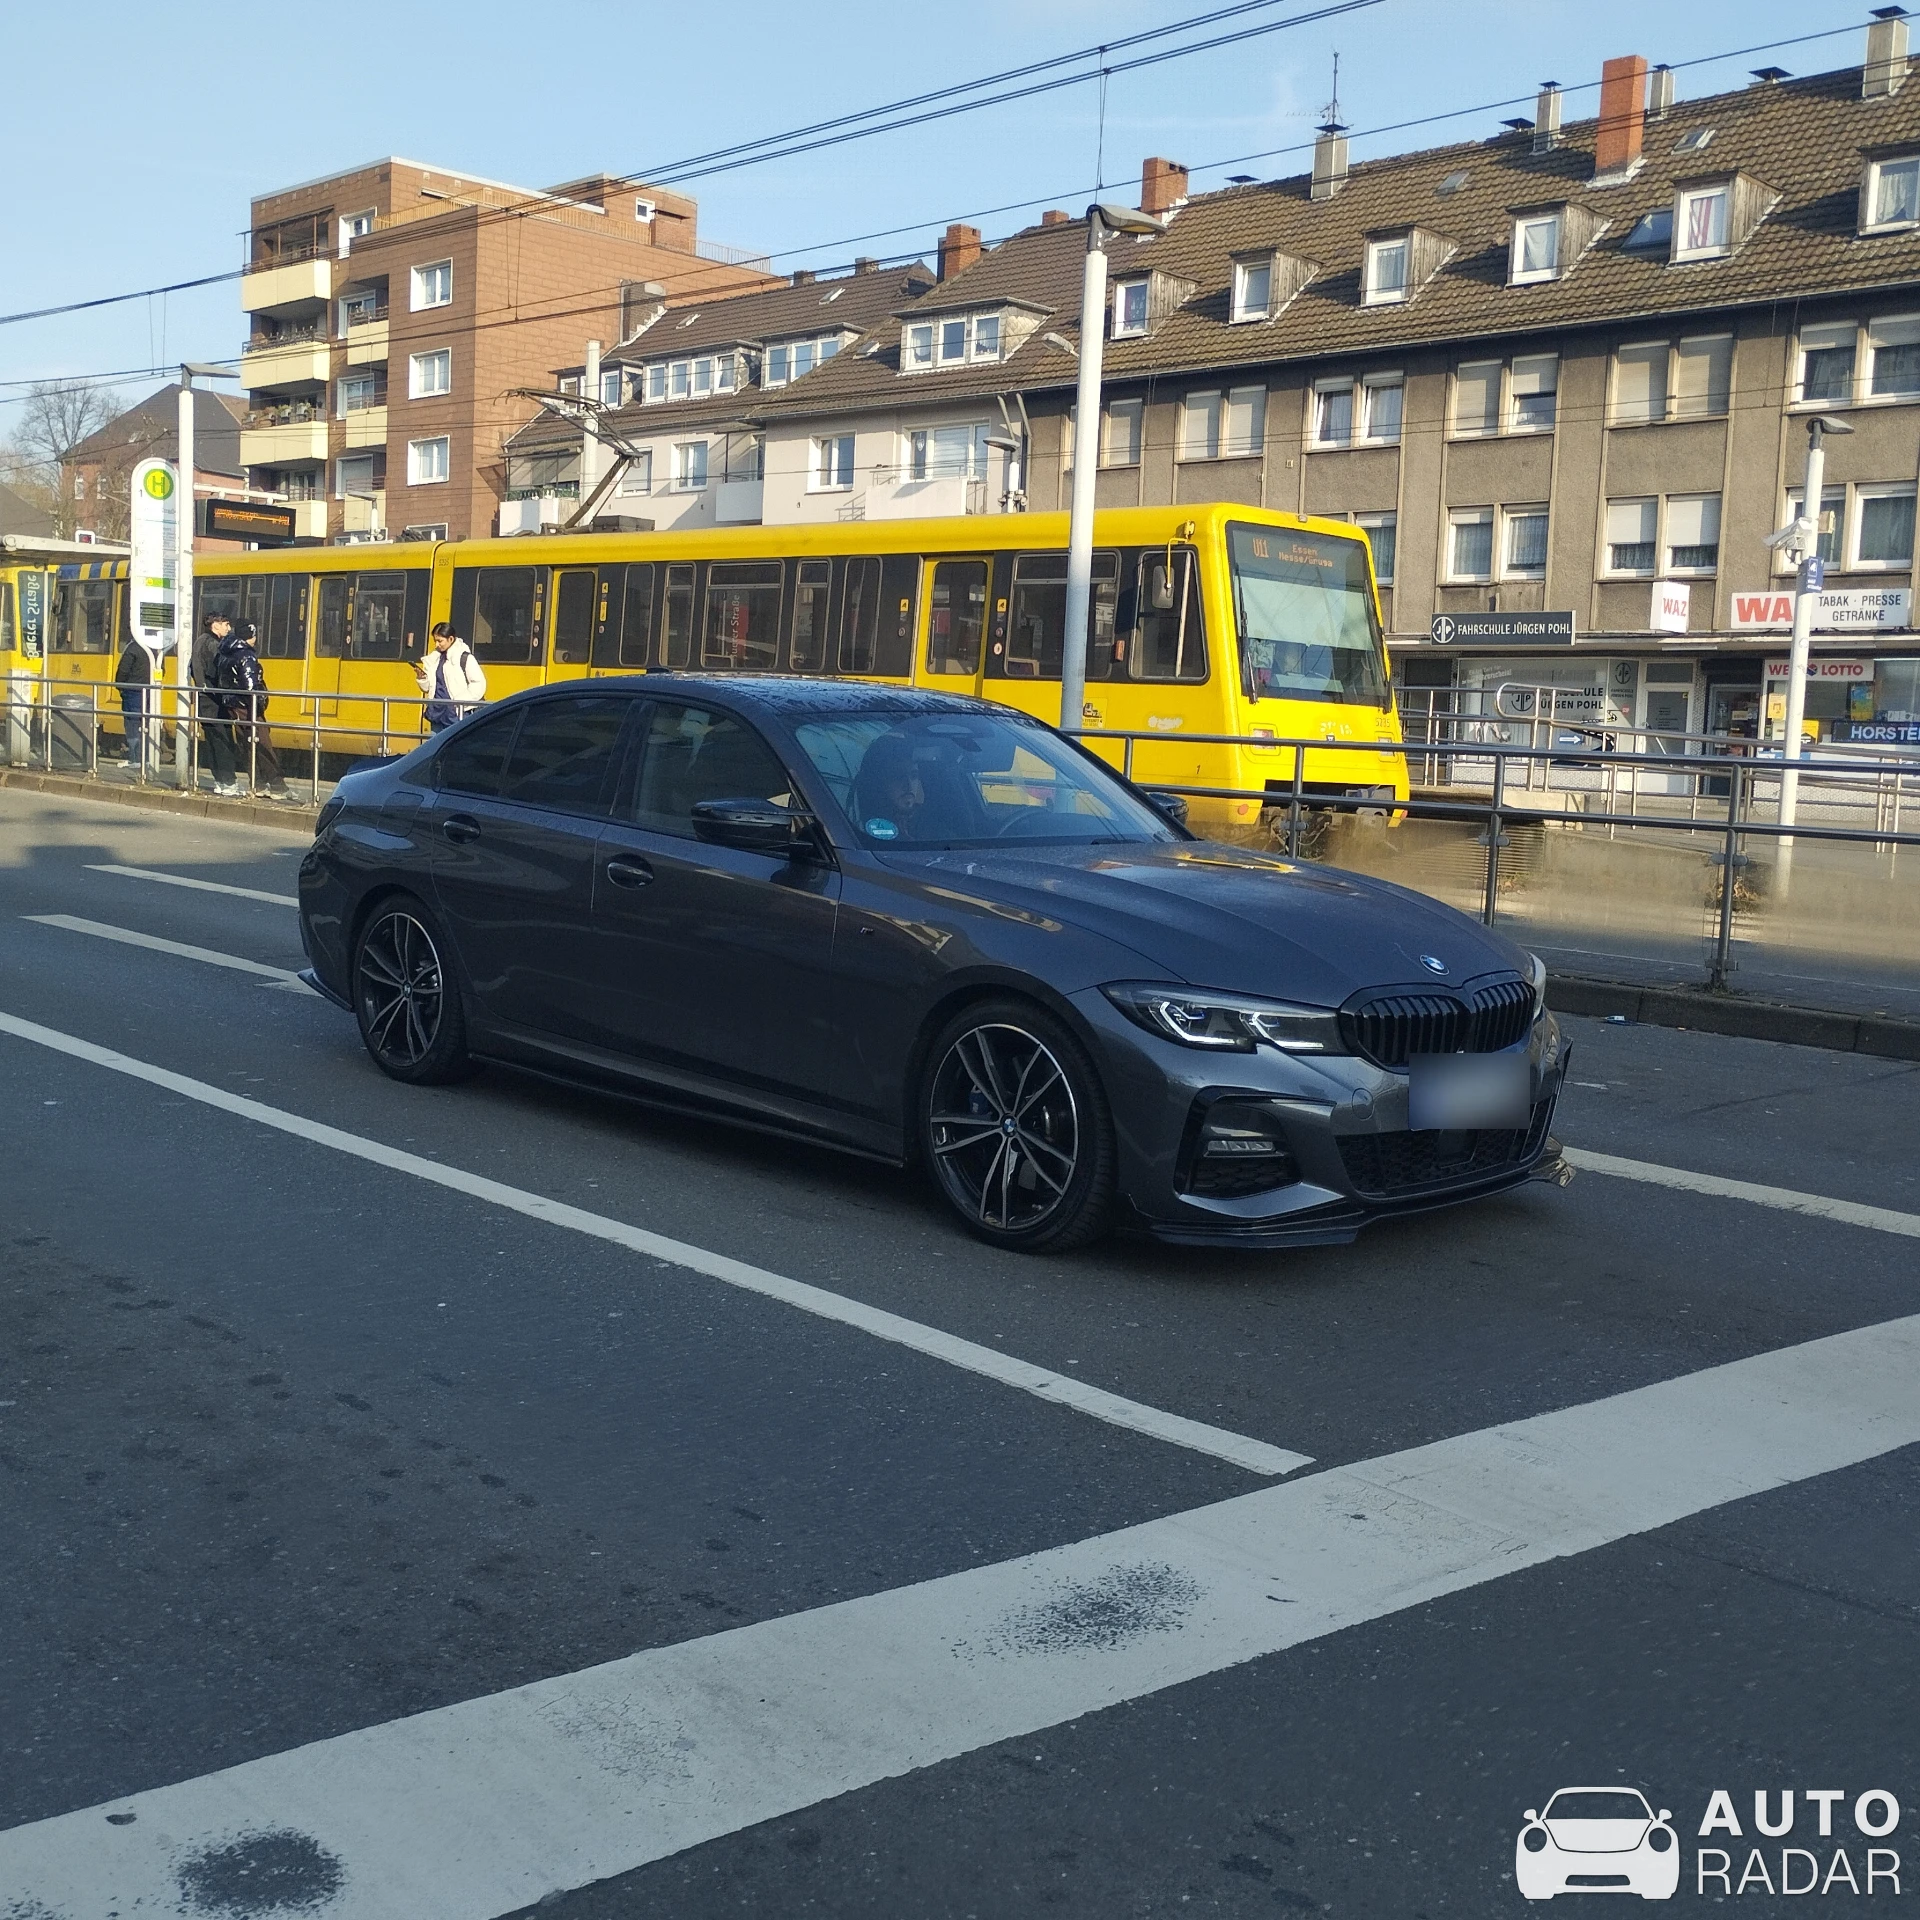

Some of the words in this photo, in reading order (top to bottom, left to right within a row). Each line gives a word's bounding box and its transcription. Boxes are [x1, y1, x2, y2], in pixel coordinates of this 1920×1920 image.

[151, 475, 166, 495] H
[1252, 537, 1269, 558] U11
[1292, 544, 1318, 556] Essen
[1662, 597, 1687, 618] WAZ
[1818, 596, 1849, 607] TABAK
[1861, 594, 1902, 607] PRESSE
[730, 594, 741, 627] Straße
[1736, 597, 1793, 623] WA
[1832, 607, 1885, 622] GETRÄNKE
[1457, 623, 1510, 636] FAHRSCHULE
[1512, 621, 1545, 636] JÜRGEN
[1547, 623, 1572, 634] POHL
[730, 629, 739, 658] uerer
[1768, 664, 1789, 676] WE
[1821, 664, 1864, 676] LOTTO
[1576, 700, 1604, 710] POHL
